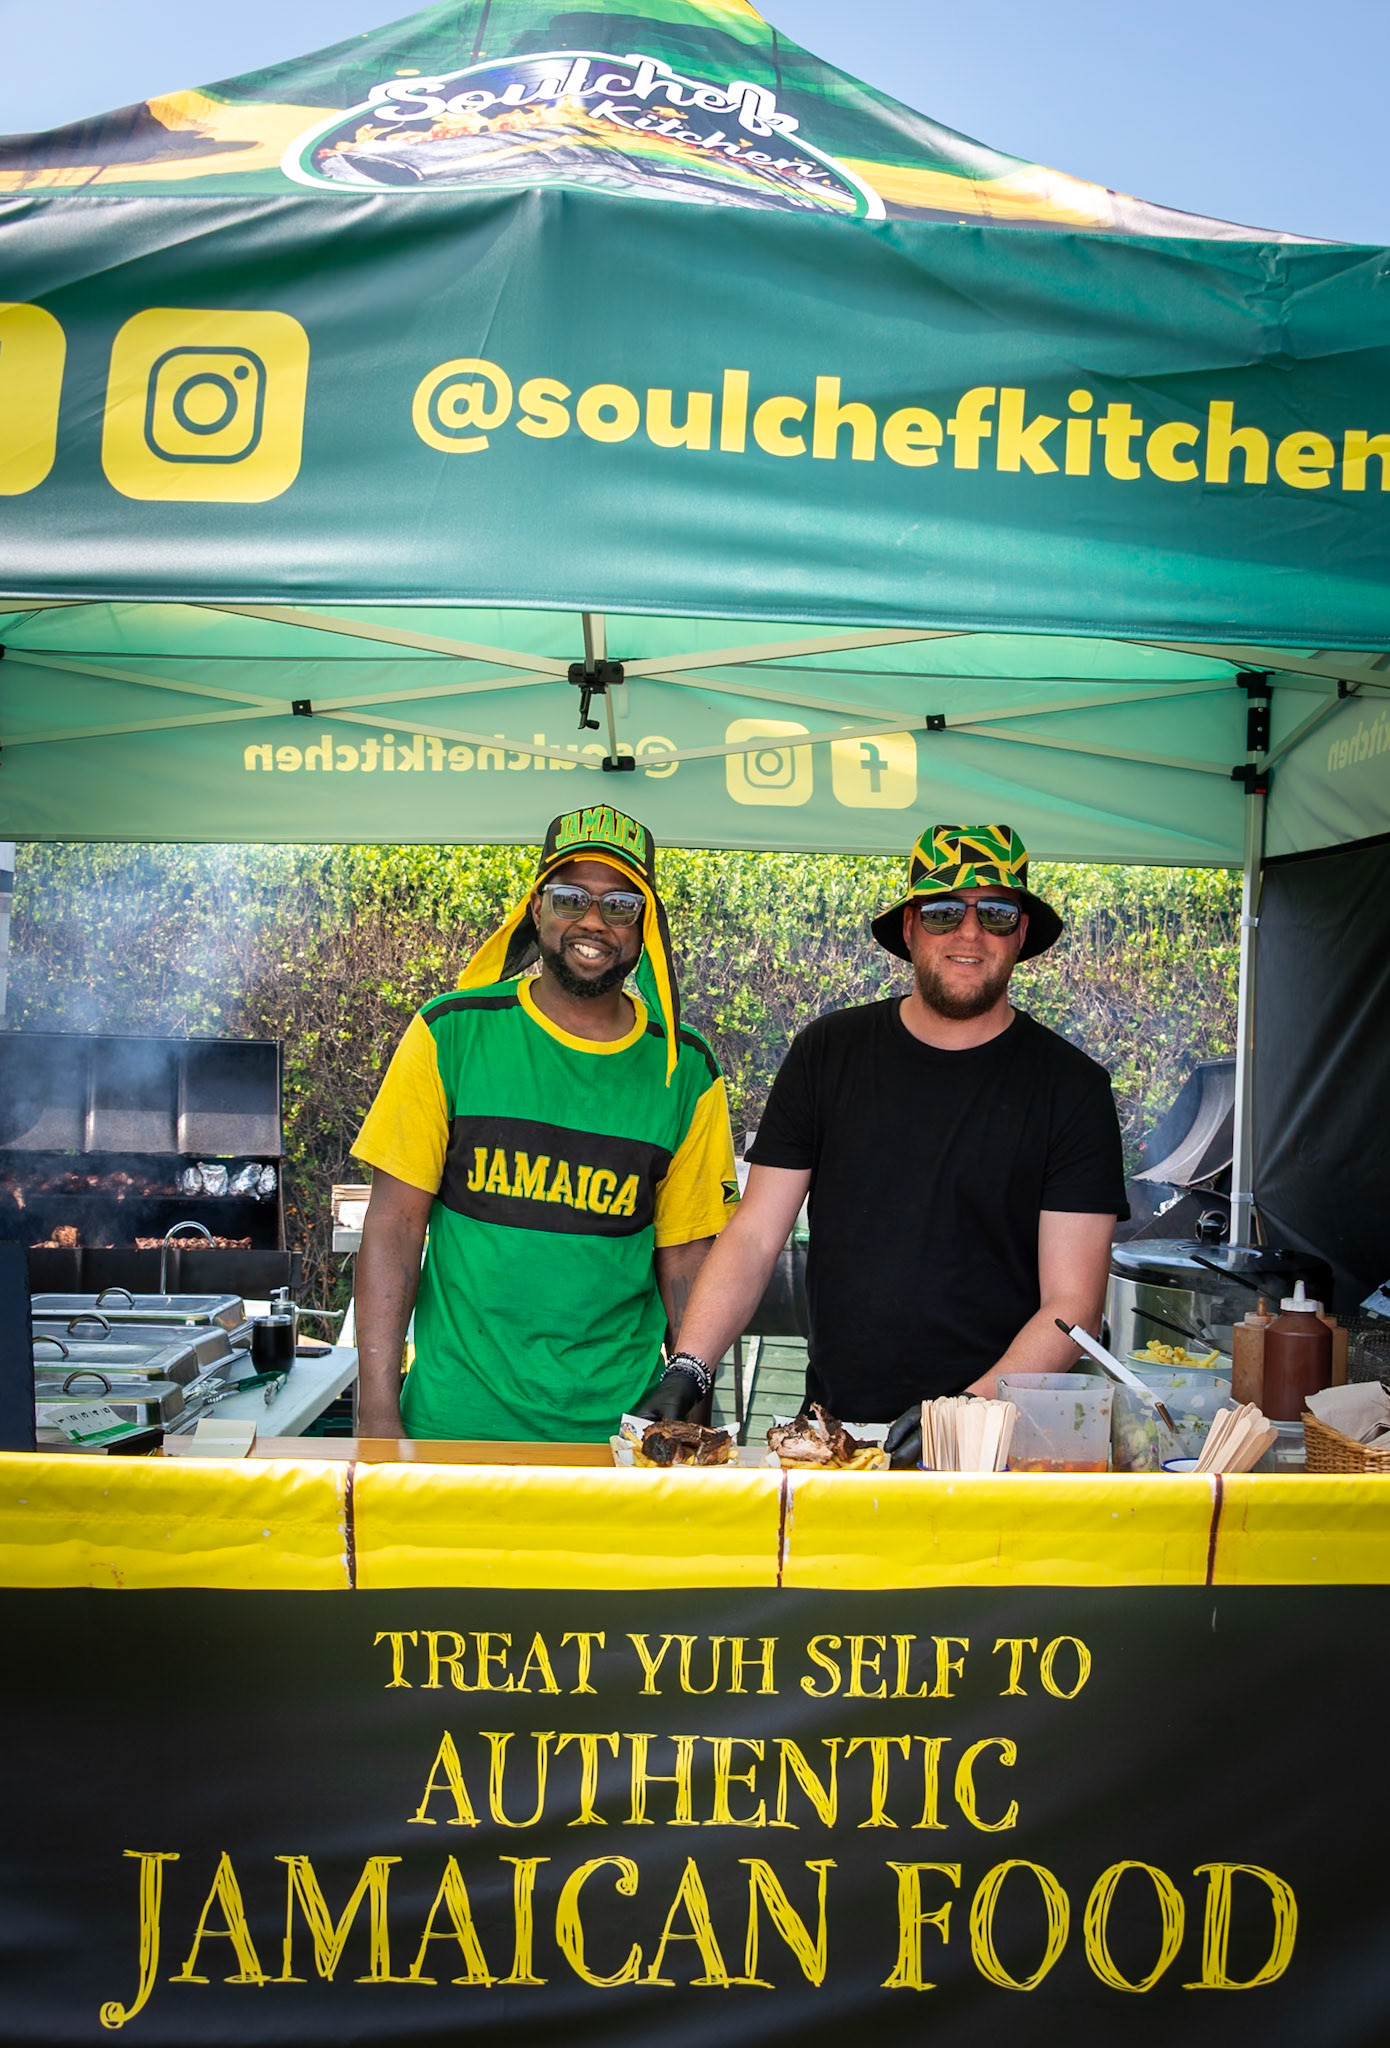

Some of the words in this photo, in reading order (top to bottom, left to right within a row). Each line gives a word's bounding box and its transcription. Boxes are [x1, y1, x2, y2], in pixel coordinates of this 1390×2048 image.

[372, 56, 792, 137] Soulchef
[588, 99, 830, 179] Kitchen
[411, 358, 1390, 492] @soulchefkitchen
[555, 806, 646, 864] JAMAICA
[466, 1146, 641, 1217] JAMAICA
[373, 1630, 605, 1695] TREAT
[626, 1633, 779, 1695] YUH
[800, 1635, 970, 1699] SELF
[992, 1636, 1092, 1699] TO
[407, 1730, 1019, 1832] AUTHENTIC
[100, 1850, 838, 2029] JAMAICAN
[879, 1859, 1298, 1993] FOOD
